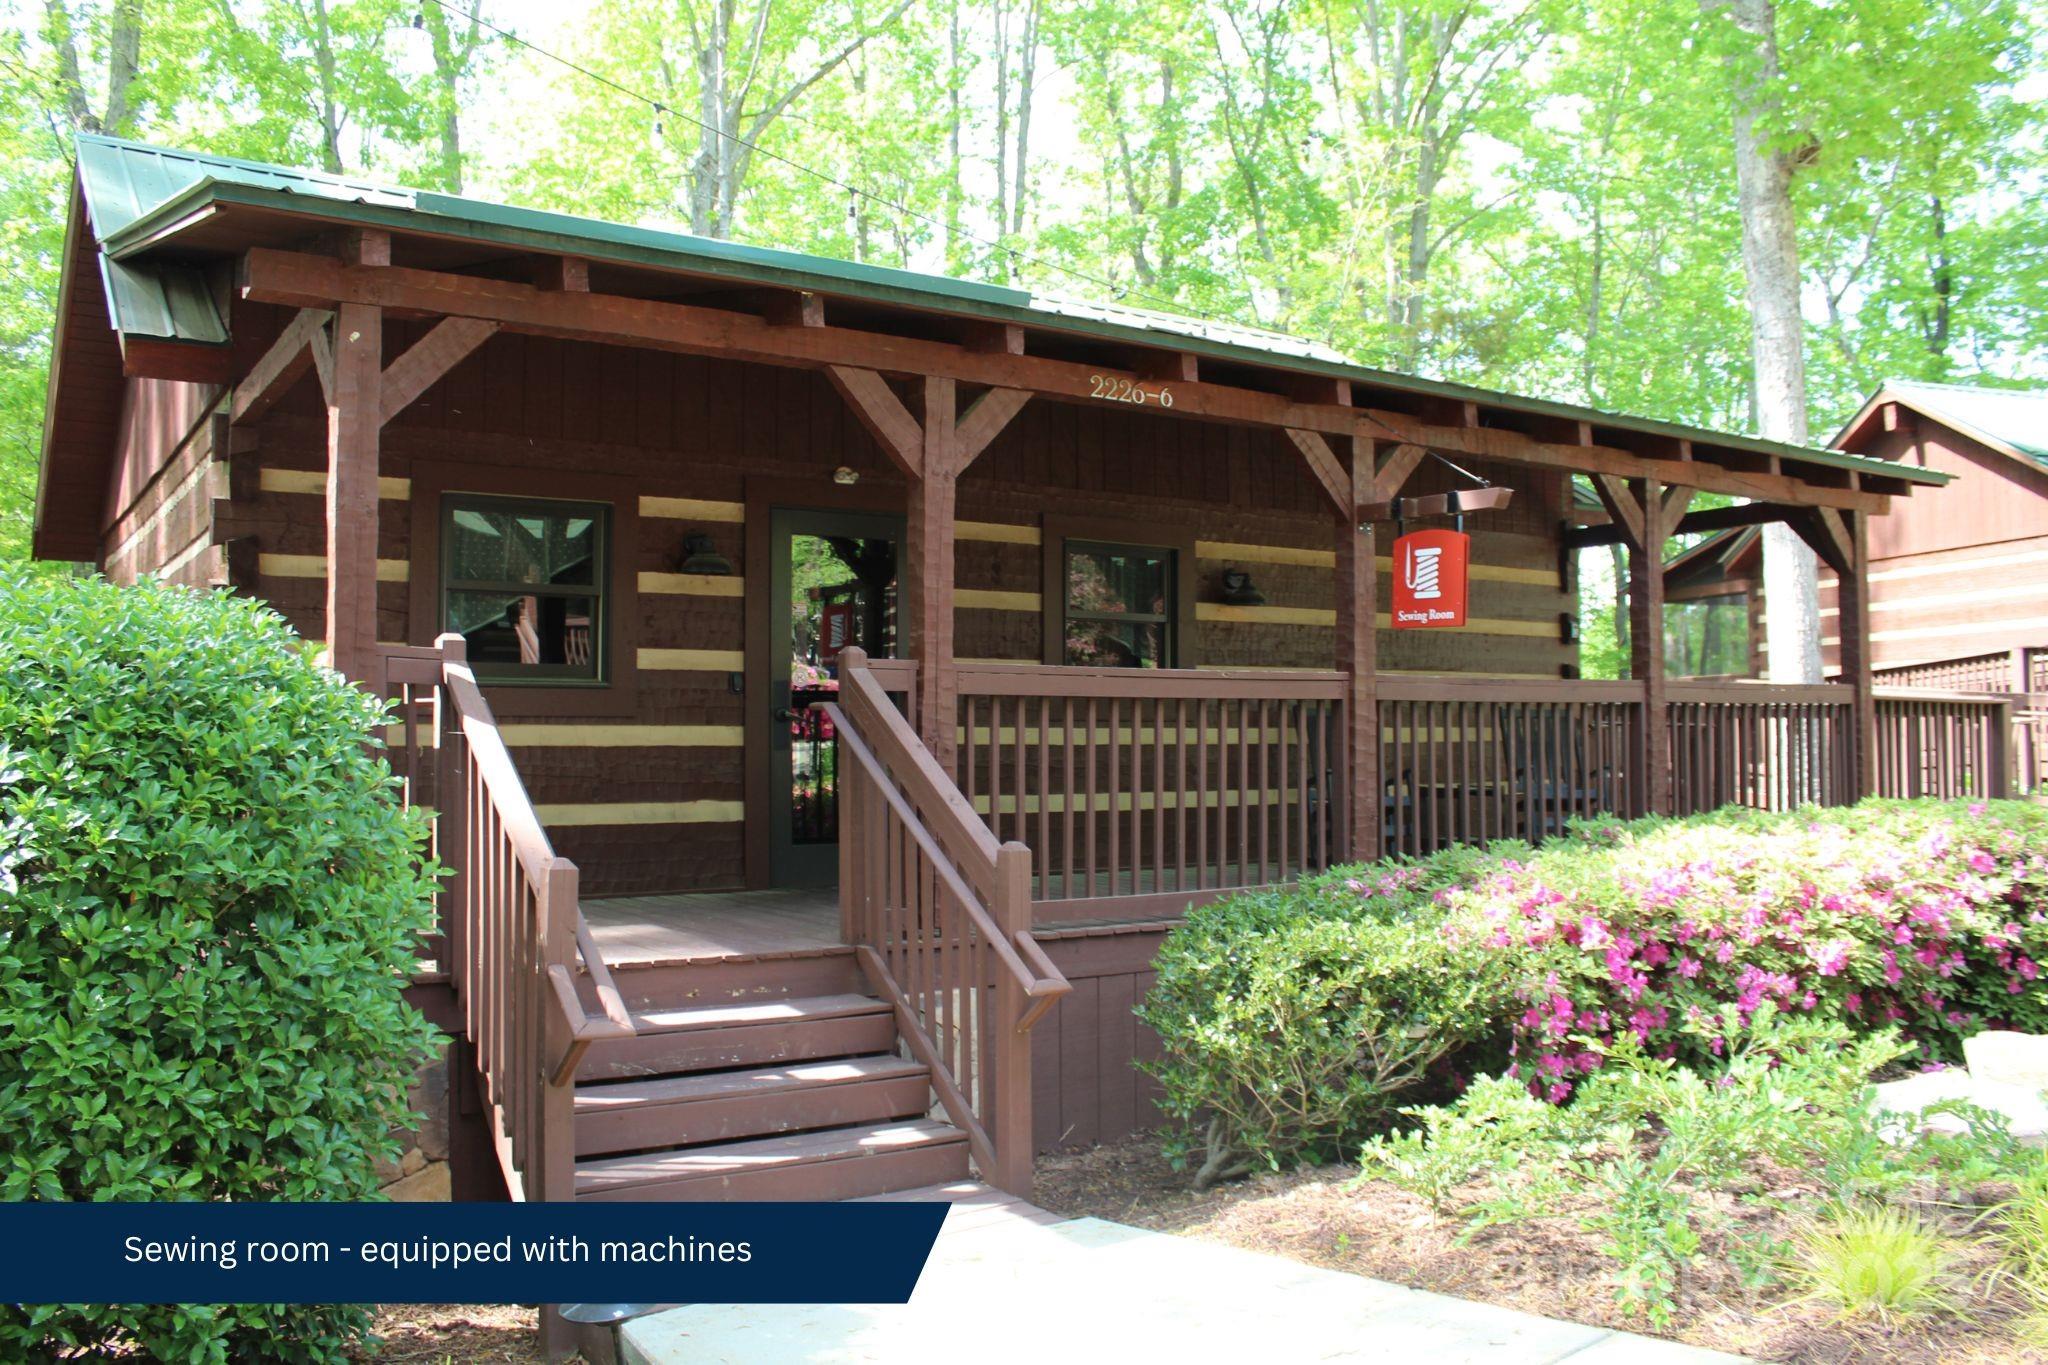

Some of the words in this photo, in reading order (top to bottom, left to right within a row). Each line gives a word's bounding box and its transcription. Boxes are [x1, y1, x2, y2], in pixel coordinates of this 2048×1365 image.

[1090, 374, 1173, 407] 2226-6
[1398, 610, 1428, 624] Sewing
[1429, 608, 1455, 620] Room
